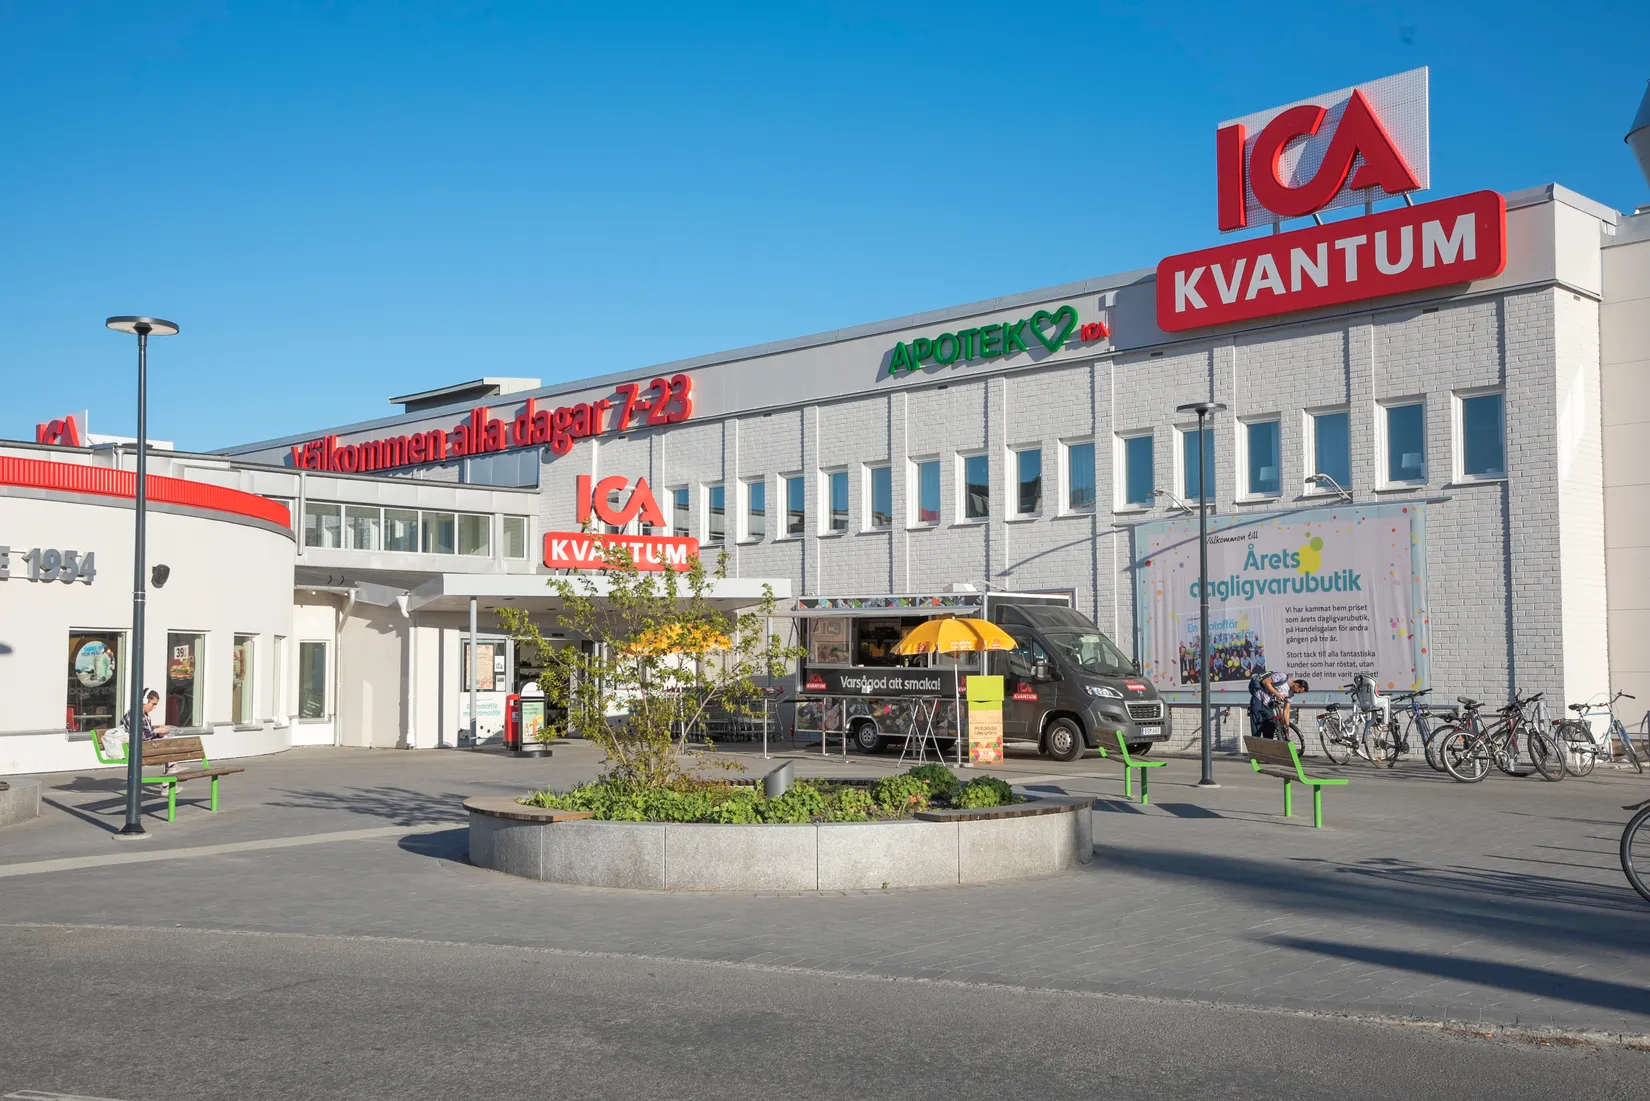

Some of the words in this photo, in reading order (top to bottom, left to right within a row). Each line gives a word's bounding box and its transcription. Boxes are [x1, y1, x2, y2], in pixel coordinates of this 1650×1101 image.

[1217, 88, 1421, 231] ICA
[1174, 212, 1477, 313] KVANTUM
[1081, 321, 1111, 341] ICA
[888, 318, 1027, 374] APOTEK
[36, 416, 80, 447] ICA
[291, 428, 446, 473] Välkommen
[451, 406, 506, 456] alla
[512, 397, 610, 455] dagar
[616, 373, 692, 430] 7-23
[576, 474, 667, 527] ICA
[1247, 531, 1258, 540] till
[22, 547, 96, 585] 1954
[1243, 543, 1301, 571] Årets
[1190, 569, 1362, 602] dagligvarubutik
[1348, 604, 1368, 613] priset
[1187, 623, 1198, 633] En
[1208, 619, 1239, 630] ataffär
[1300, 615, 1316, 623] årets
[1317, 614, 1370, 624] dagligvarubutik,
[1285, 626, 1293, 634] på
[1295, 625, 1337, 634] Handelsgalan
[1286, 636, 1309, 645] gången
[1336, 660, 1358, 668] röstat,
[809, 673, 823, 683] ICA
[840, 675, 887, 692] Varsågod
[889, 677, 903, 690] att
[904, 677, 941, 691] smaka!
[1017, 682, 1033, 693] ICA
